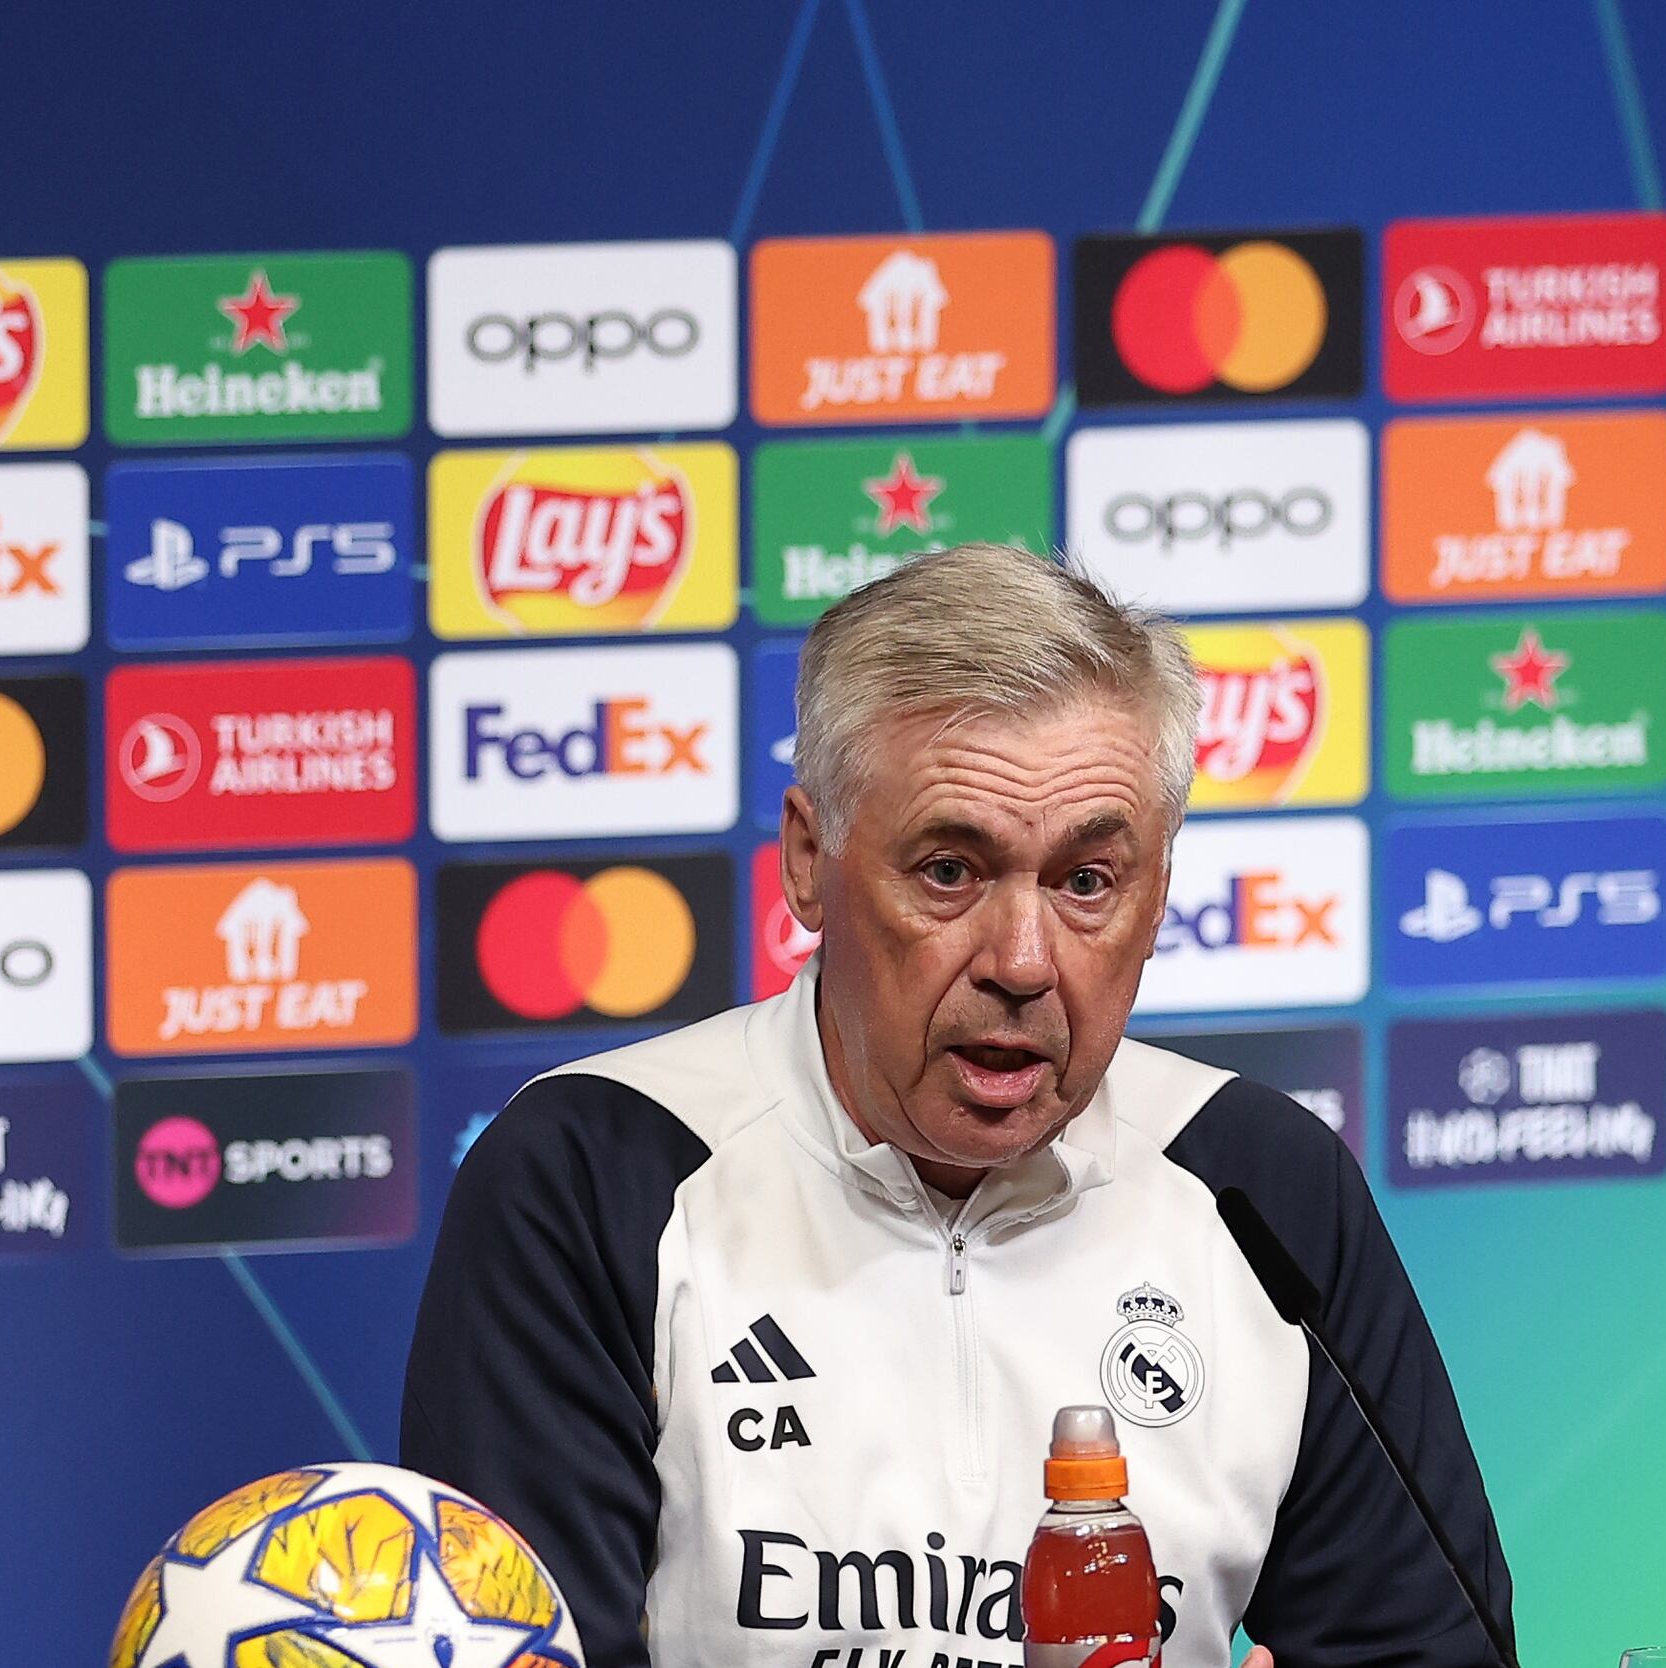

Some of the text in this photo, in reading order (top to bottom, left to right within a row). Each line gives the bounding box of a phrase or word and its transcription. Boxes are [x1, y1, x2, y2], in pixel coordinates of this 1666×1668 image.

[1483, 263, 1661, 307] TURKISH
[465, 309, 700, 372] oppo
[1481, 300, 1662, 349] AIRLINES
[134, 365, 382, 418] Heineken
[800, 352, 1007, 408] JUST EAT
[489, 481, 679, 604] Lay's
[1104, 487, 1332, 549] oppo
[219, 522, 397, 577] PS5
[1429, 529, 1632, 586] JUST EAT
[210, 712, 394, 753] TURKISH
[463, 696, 711, 784] FedEx
[1411, 718, 1645, 775] Heineken
[210, 751, 396, 795] AIRLINES
[1153, 871, 1339, 952] edEx
[1488, 871, 1662, 931] PS5
[157, 980, 368, 1039] JUST EAT
[1518, 1042, 1599, 1100] THAT
[224, 1136, 392, 1184] SPORTS
[727, 1405, 811, 1451] CA
[736, 1529, 1184, 1646] Emiras
